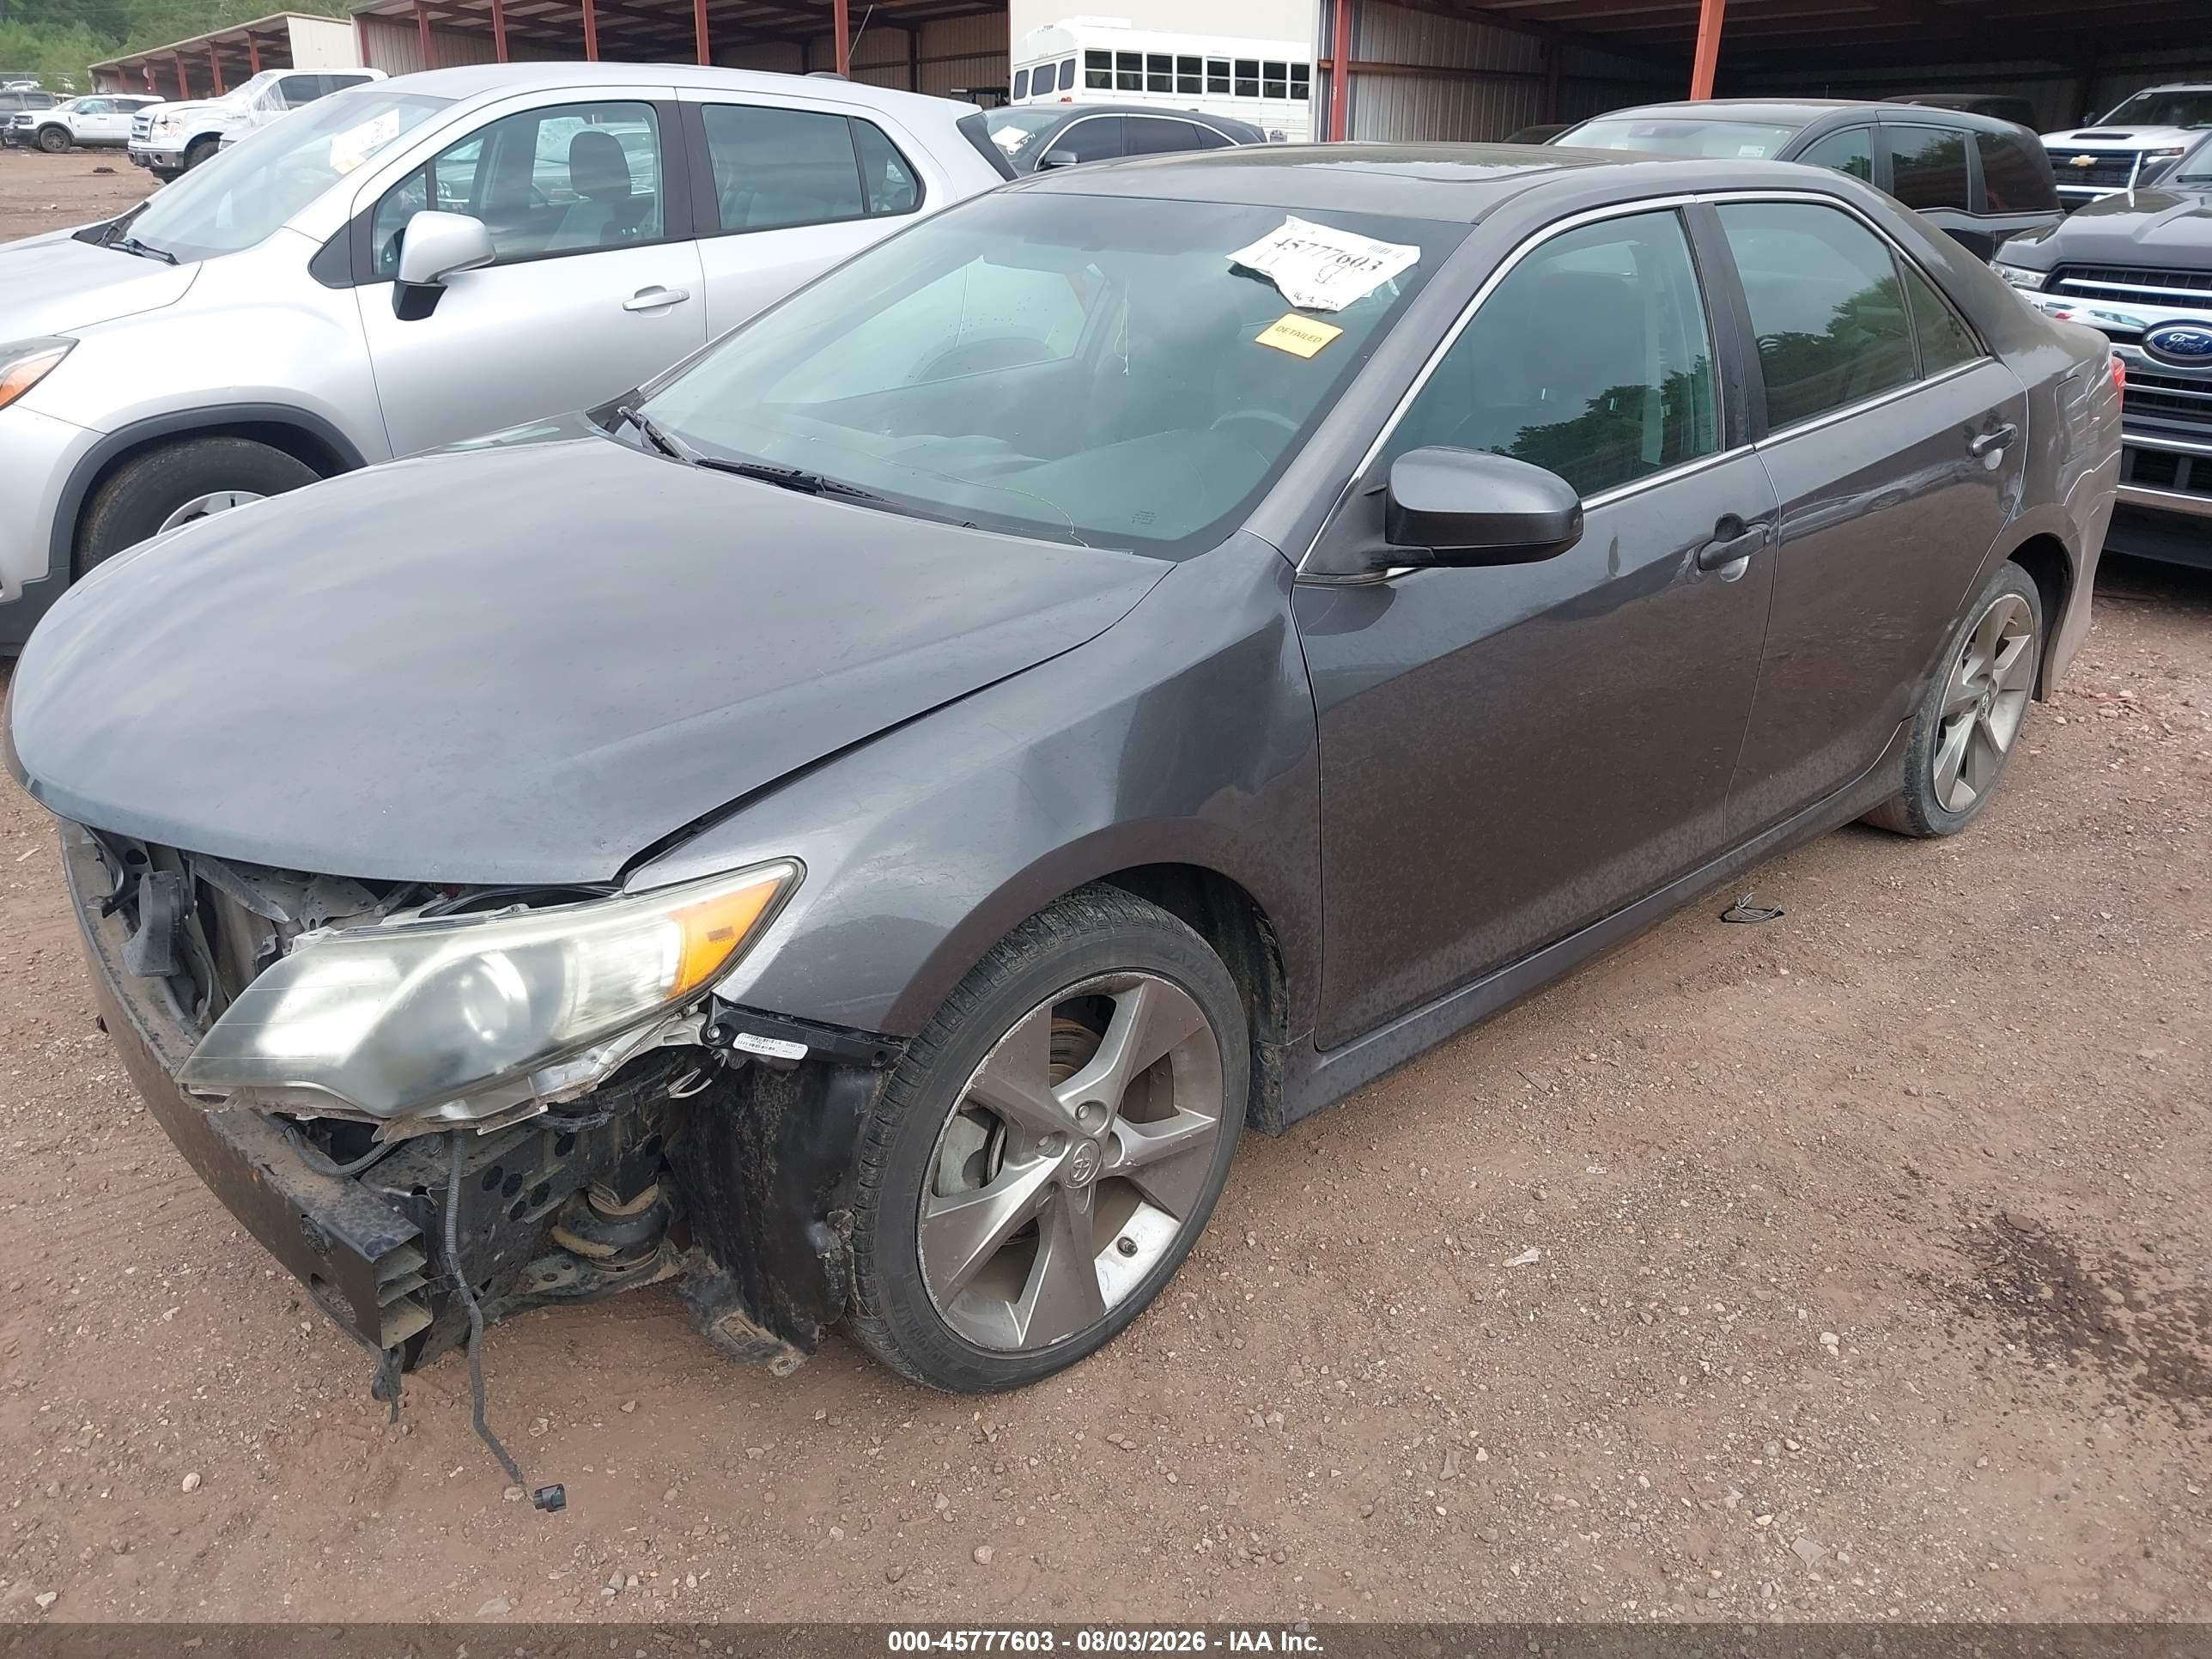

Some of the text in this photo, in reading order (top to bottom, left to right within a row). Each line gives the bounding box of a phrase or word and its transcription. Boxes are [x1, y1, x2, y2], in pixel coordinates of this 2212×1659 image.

[1274, 238, 1383, 271] 45777603
[1275, 325, 1322, 343] DETAILED
[2164, 332, 2209, 353] Ford
